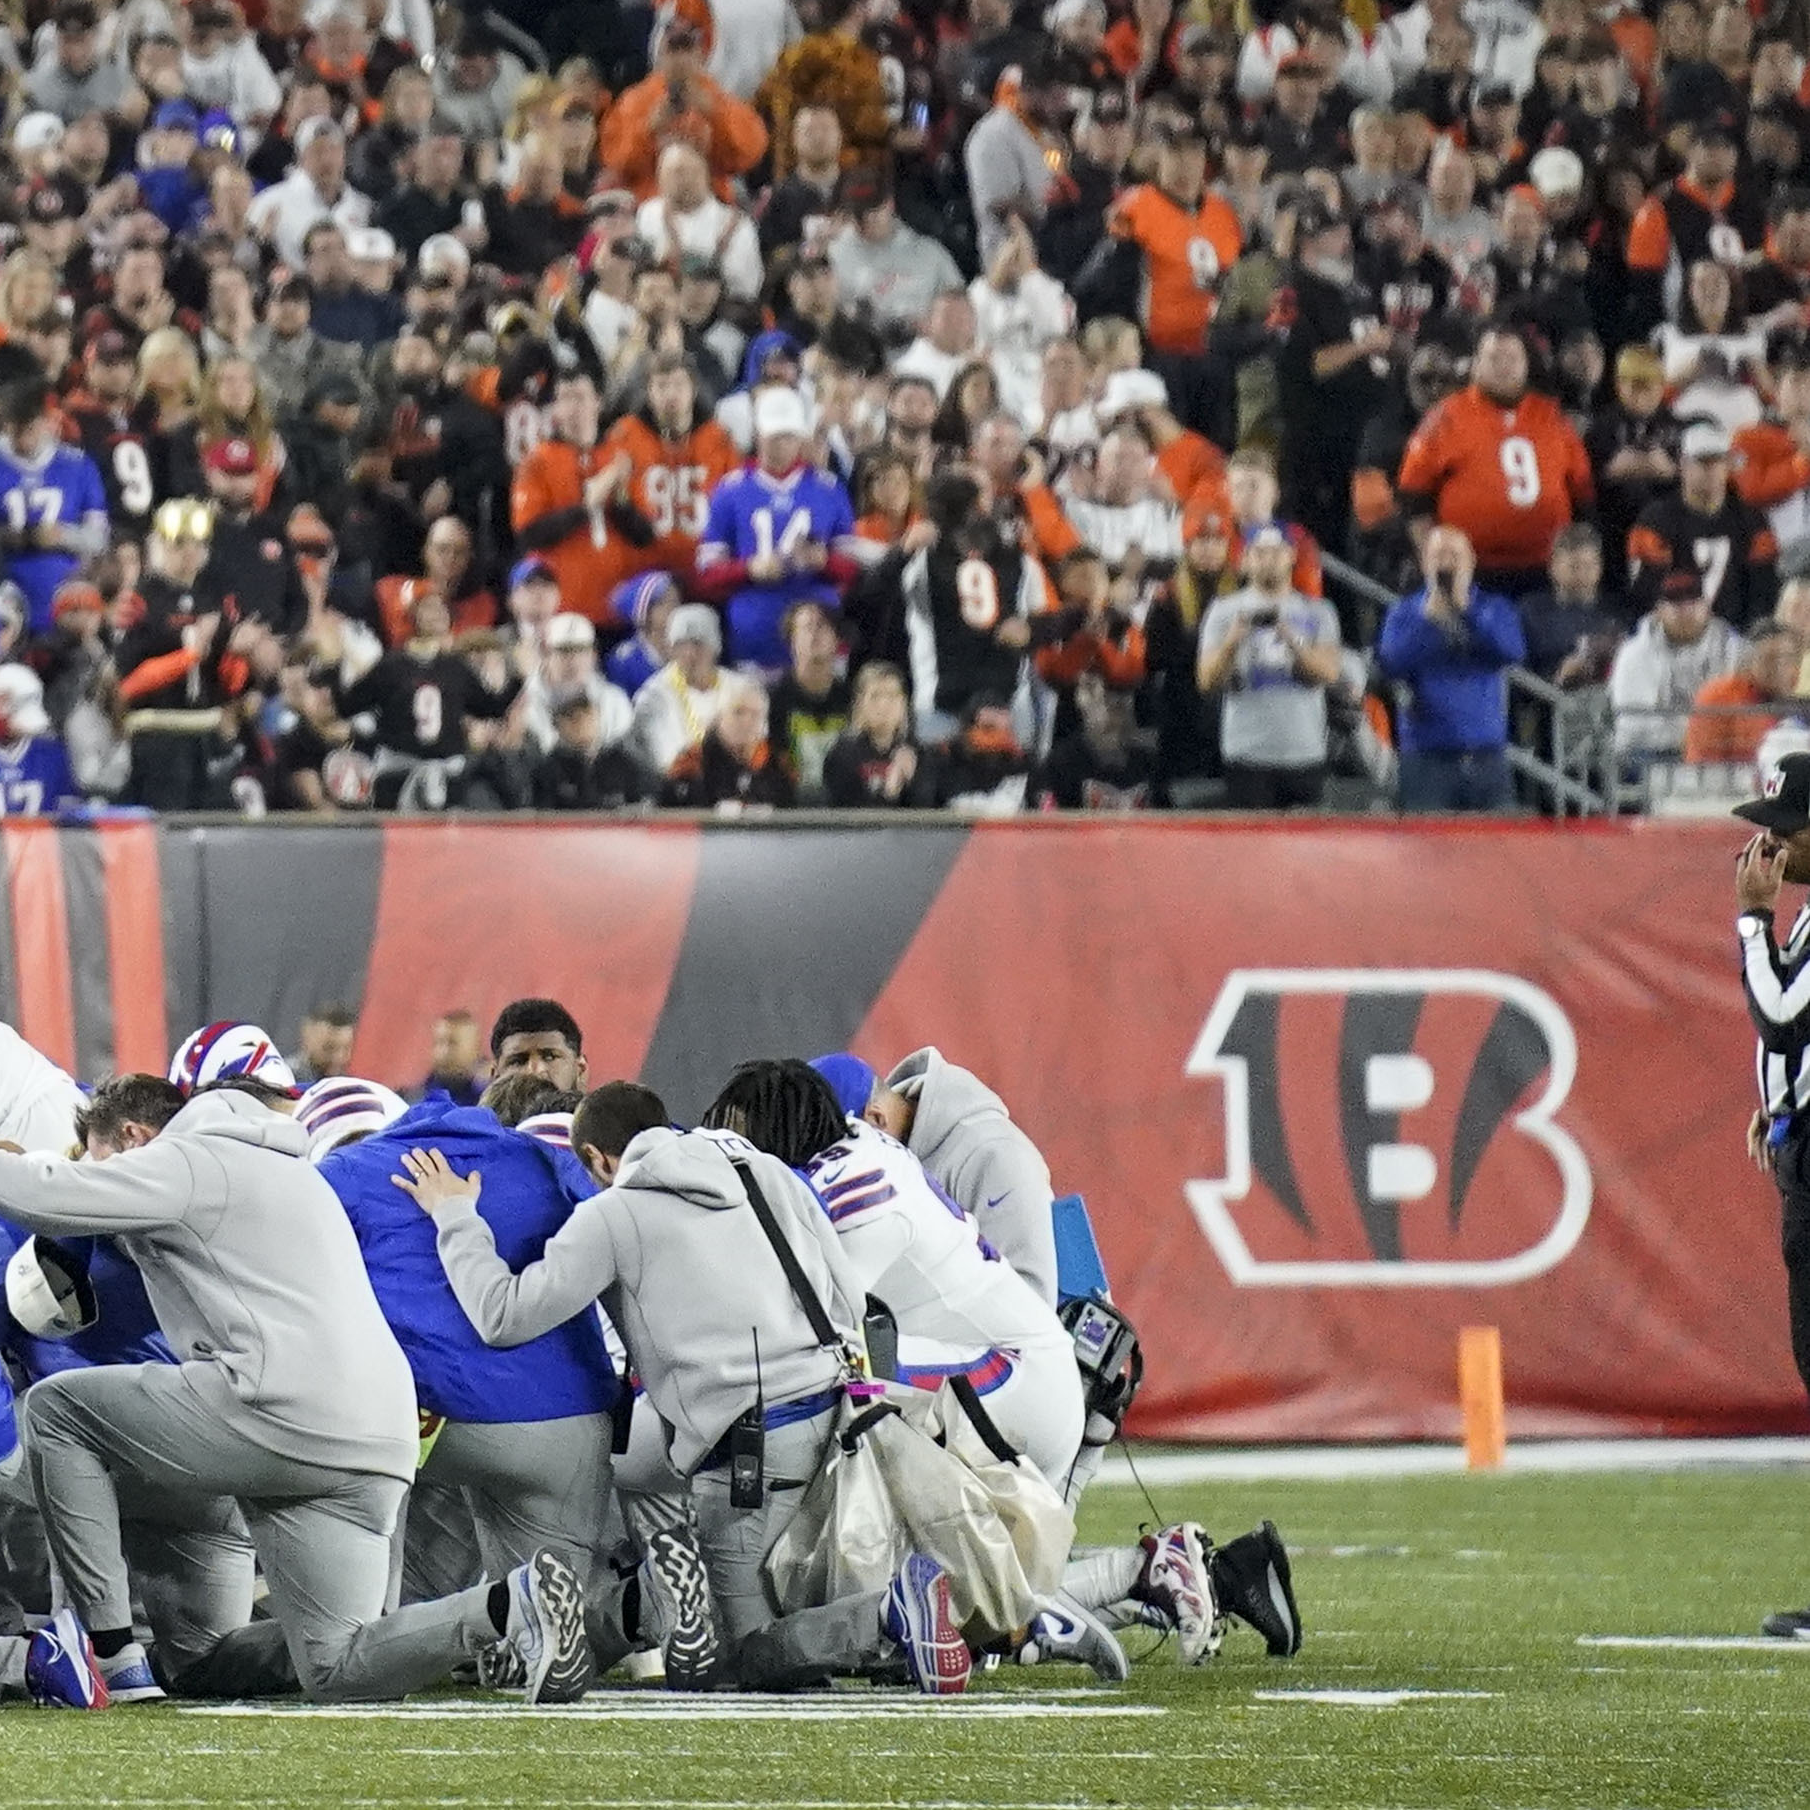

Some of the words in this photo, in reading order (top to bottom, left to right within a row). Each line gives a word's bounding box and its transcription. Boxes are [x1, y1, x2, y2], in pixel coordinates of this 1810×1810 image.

[113, 439, 155, 516] 9
[645, 465, 711, 539] 95
[1501, 436, 1542, 508] 9
[956, 558, 1000, 631] 9
[413, 683, 447, 746] 9
